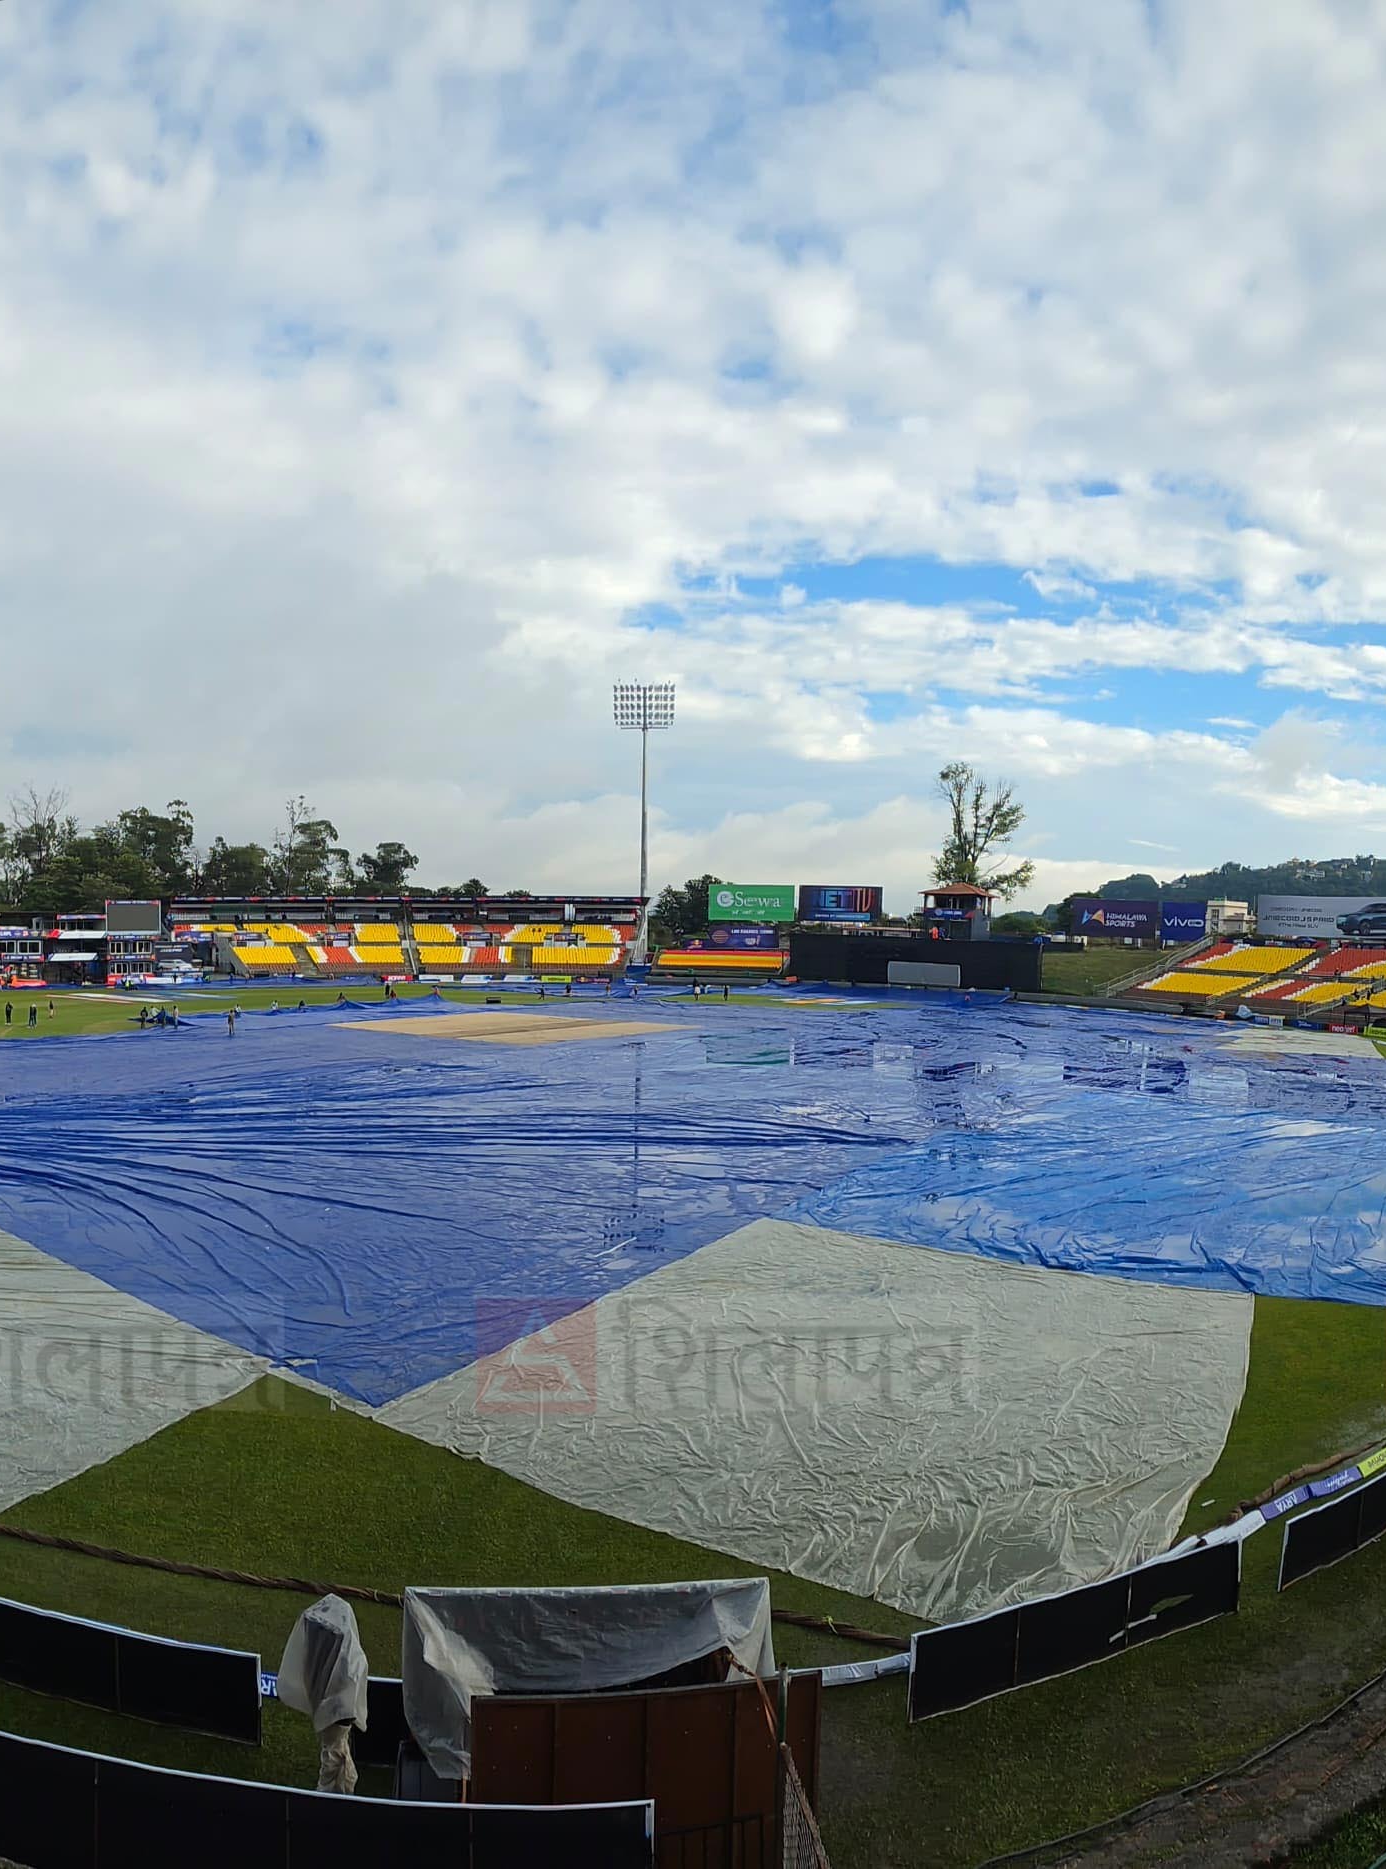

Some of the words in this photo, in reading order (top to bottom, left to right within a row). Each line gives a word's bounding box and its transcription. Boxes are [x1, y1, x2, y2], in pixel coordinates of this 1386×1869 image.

[717, 891, 782, 908] eSewa
[1104, 920, 1136, 929] SPORTS
[1164, 917, 1205, 928] vivo
